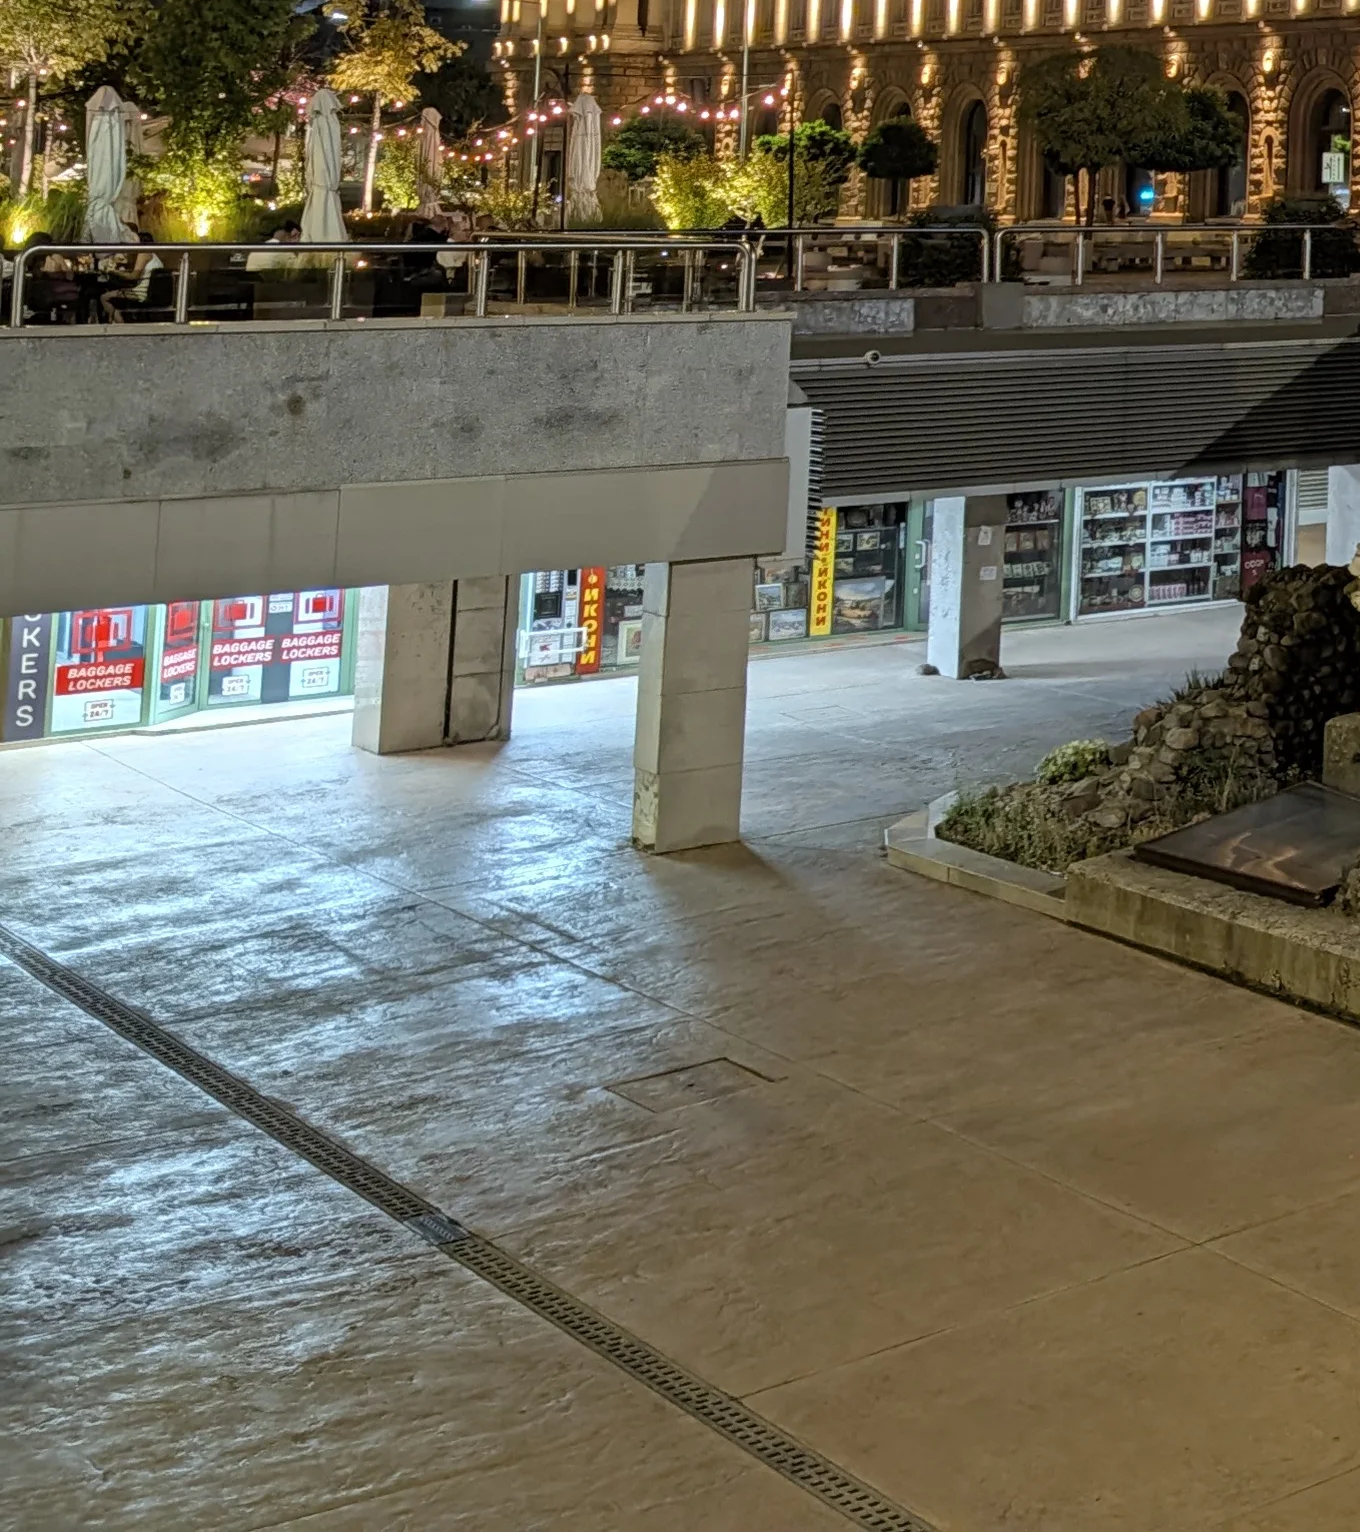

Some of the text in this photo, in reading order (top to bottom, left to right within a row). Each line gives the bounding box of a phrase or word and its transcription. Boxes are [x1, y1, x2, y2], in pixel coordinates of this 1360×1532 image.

[815, 567, 829, 627] ИКОНИ
[580, 588, 599, 665] ИКОНИ
[212, 639, 275, 655] BAGGAGE
[281, 633, 341, 649] BAGGAGE
[213, 651, 272, 666] LOCKERS
[281, 645, 339, 660] LOCKERS
[15, 614, 42, 727] KERS
[67, 663, 135, 679] BAGGAGE
[68, 676, 131, 691] LOCKERS
